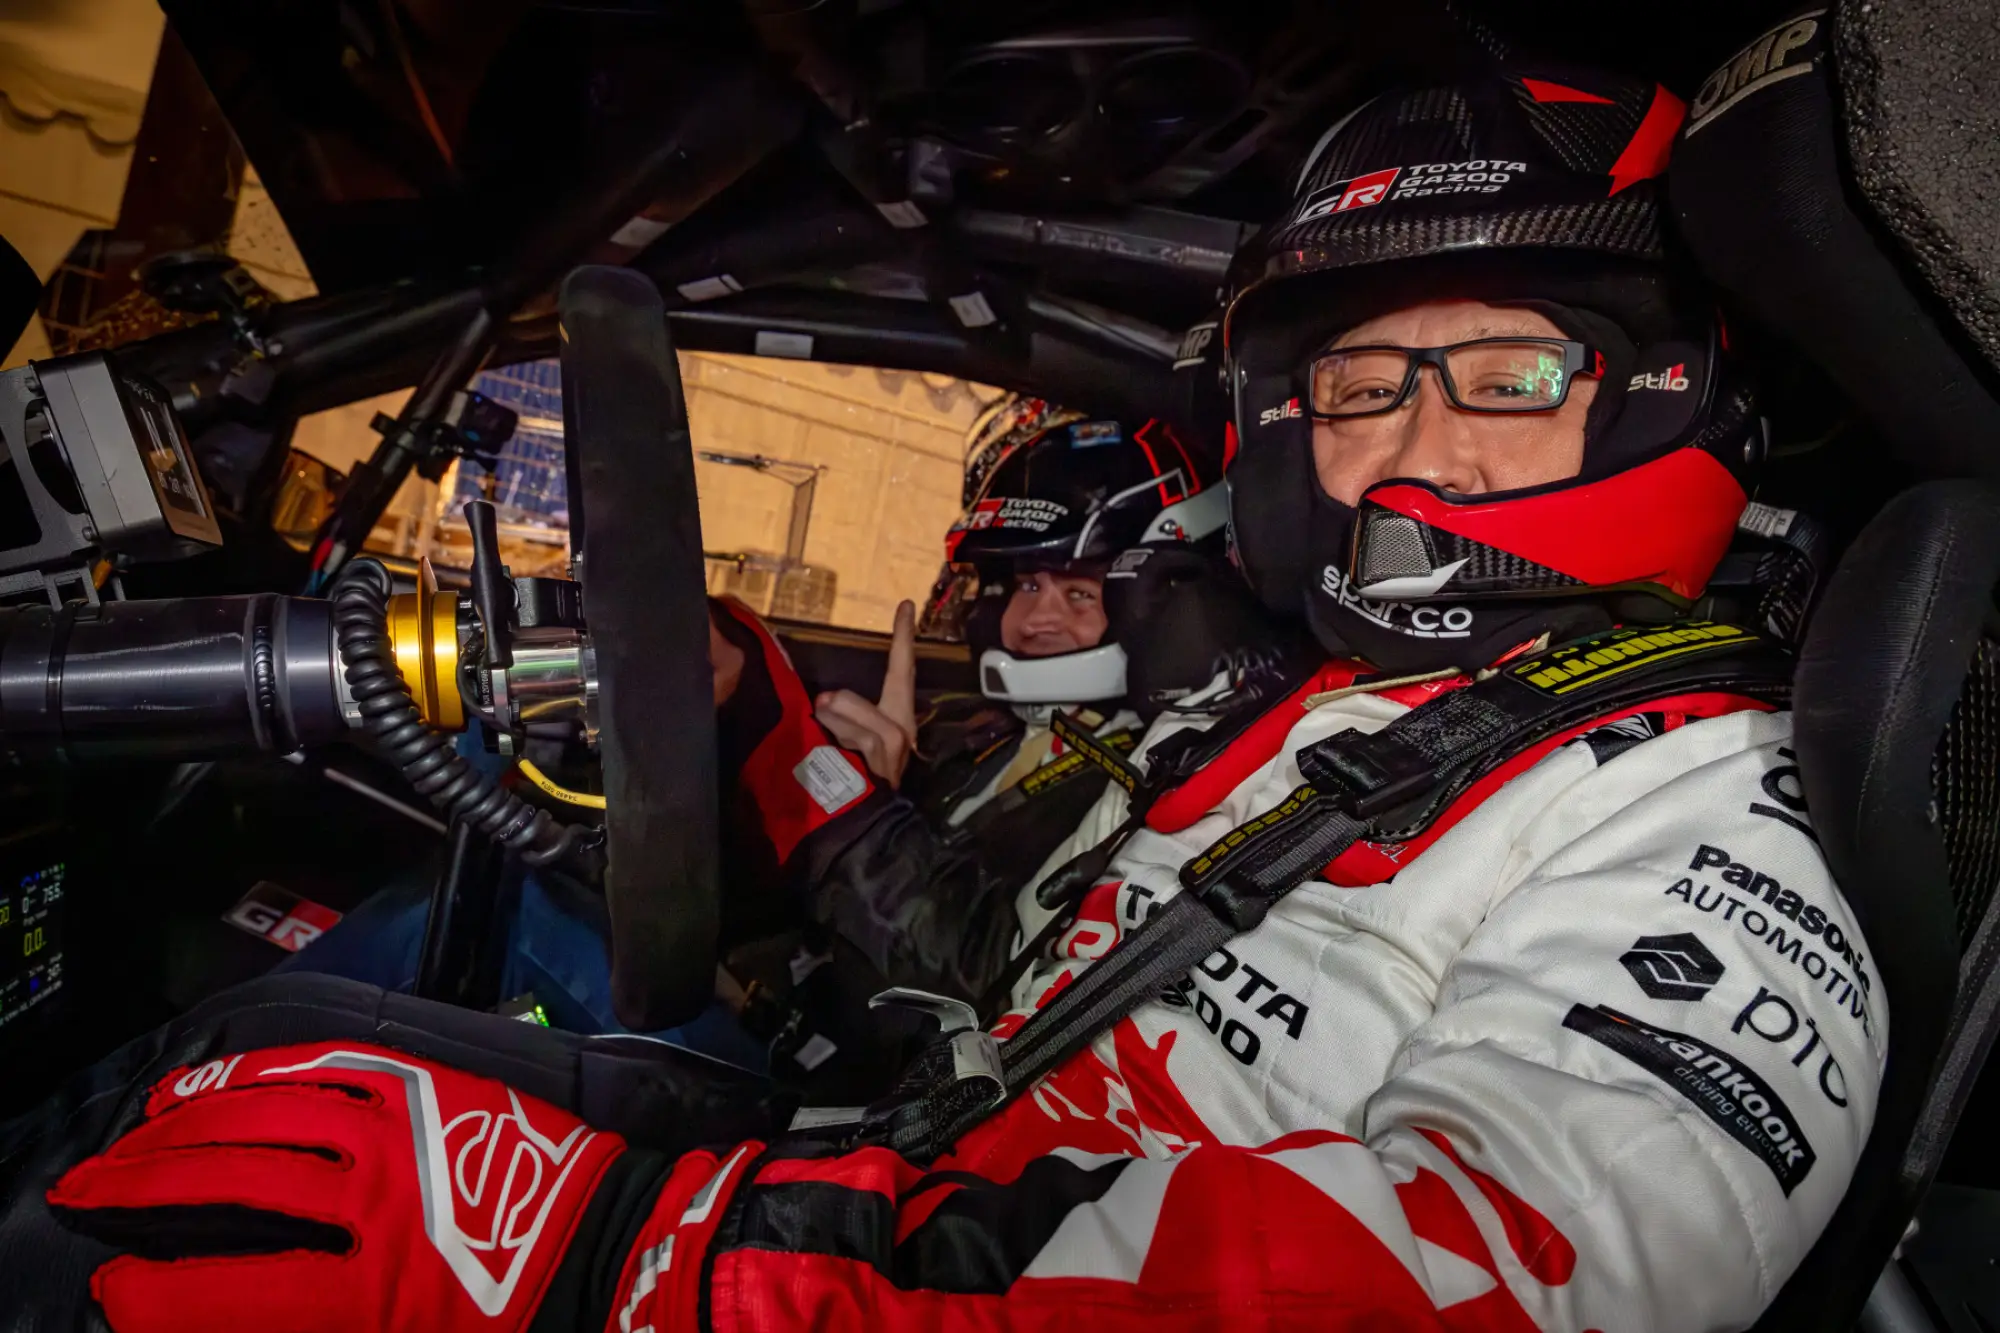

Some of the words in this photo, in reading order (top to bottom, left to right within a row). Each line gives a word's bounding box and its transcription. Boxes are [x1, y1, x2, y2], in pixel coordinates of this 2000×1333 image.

[1690, 18, 1819, 121] OMP
[1399, 172, 1511, 189] GAZOO
[1408, 159, 1528, 176] TOYOTA
[1297, 183, 1387, 224] GR
[1391, 183, 1503, 201] Racing
[998, 508, 1058, 523] GAZOO
[1006, 499, 1069, 516] TOYOTA
[231, 900, 323, 951] GR
[1663, 877, 1869, 1036] AUTOMOTIV
[1673, 1067, 1737, 1116] driving
[1735, 1113, 1789, 1179] emotion
